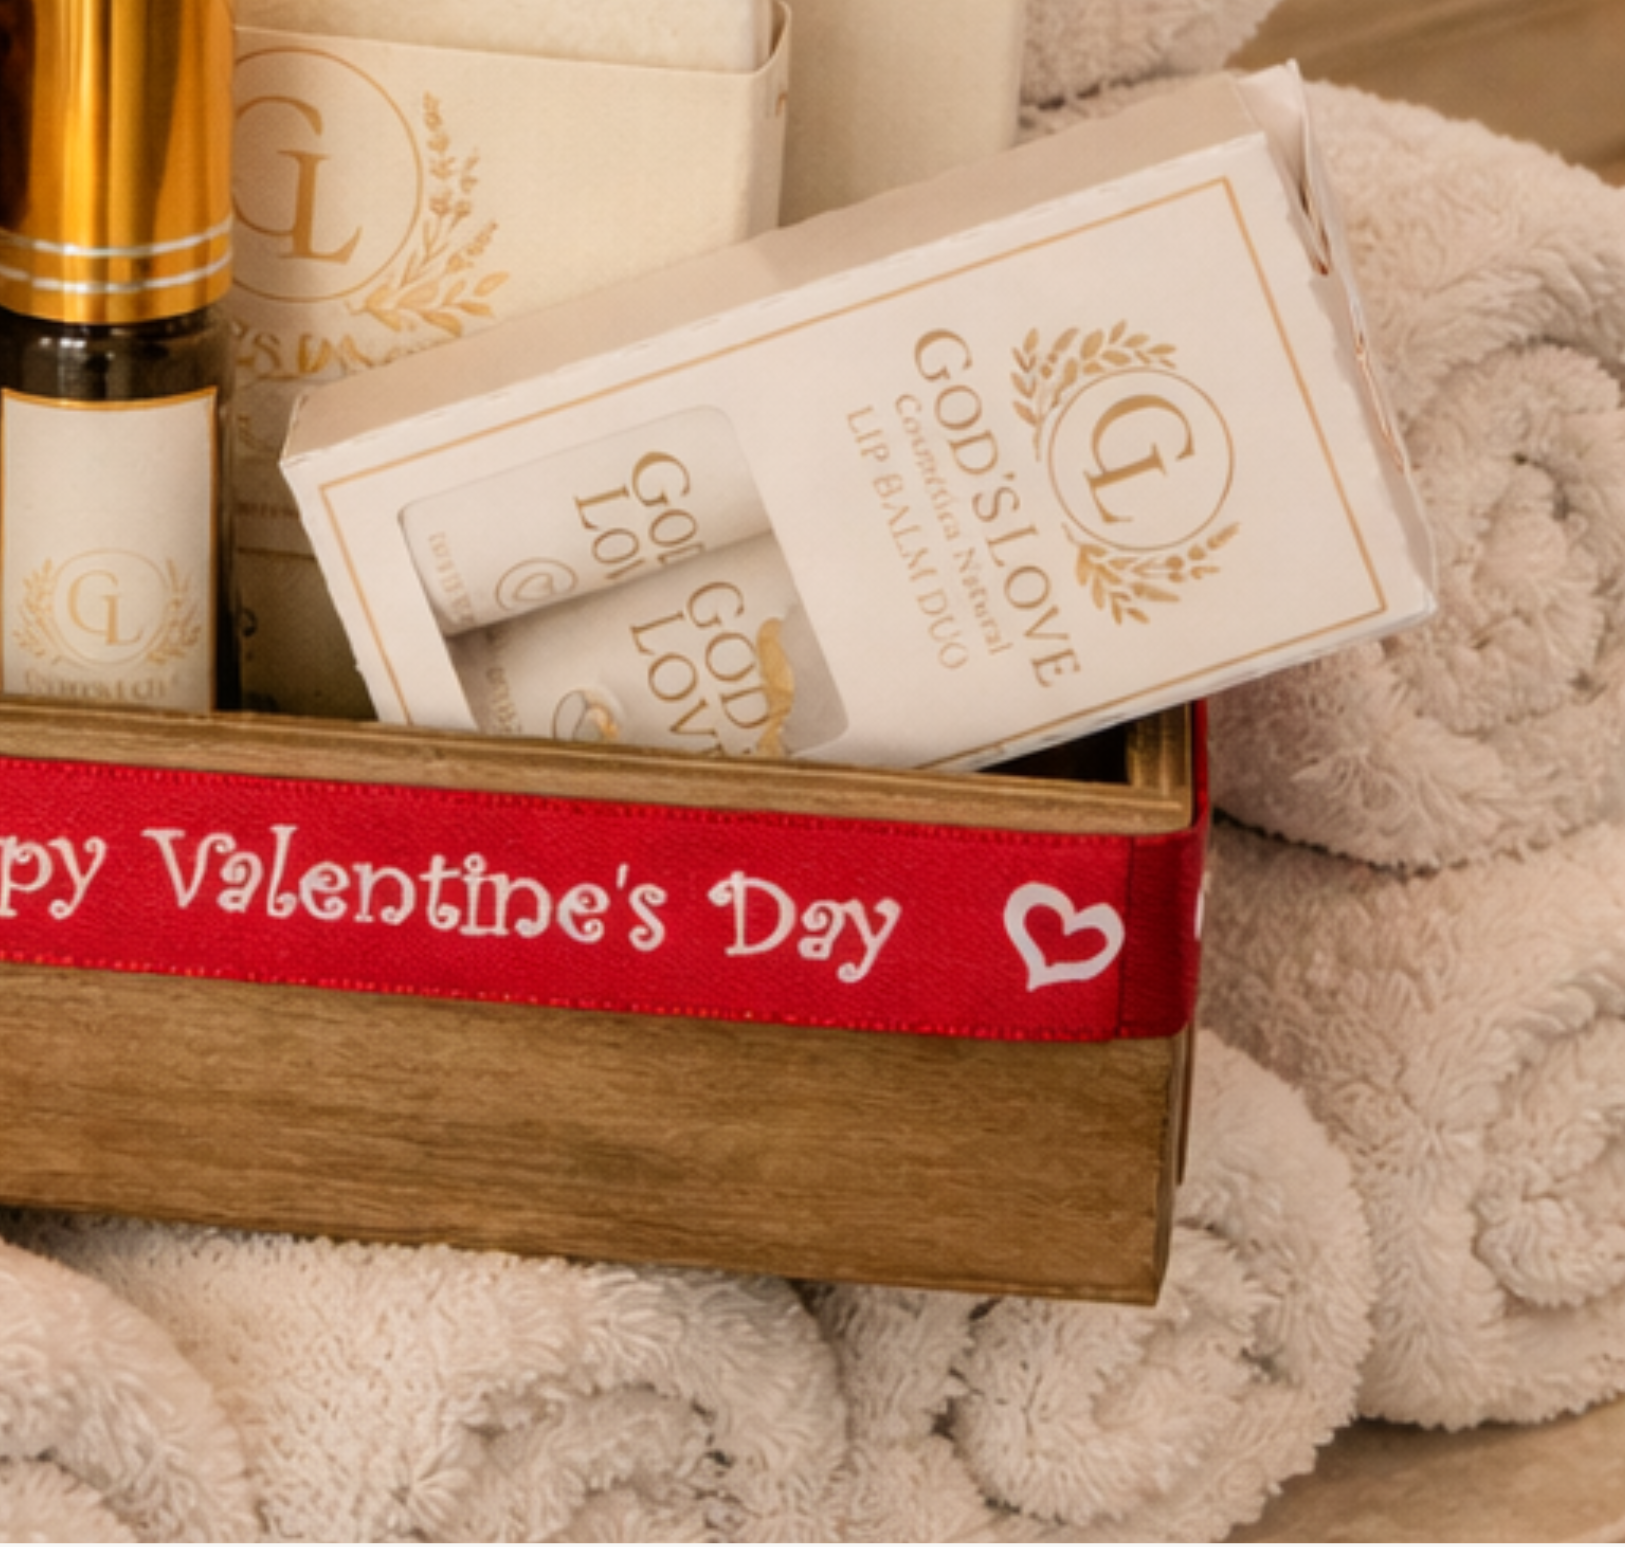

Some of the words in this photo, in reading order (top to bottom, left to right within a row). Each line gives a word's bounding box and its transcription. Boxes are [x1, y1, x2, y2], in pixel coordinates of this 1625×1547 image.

[847, 405, 891, 463] LIP
[873, 472, 937, 582] BALM
[917, 588, 969, 670] DUO
[914, 328, 1021, 523] GOD'S
[985, 524, 1081, 688] LOVE
[631, 610, 723, 754] LOV
[142, 823, 667, 952] Valentine's
[707, 870, 902, 984] Day
